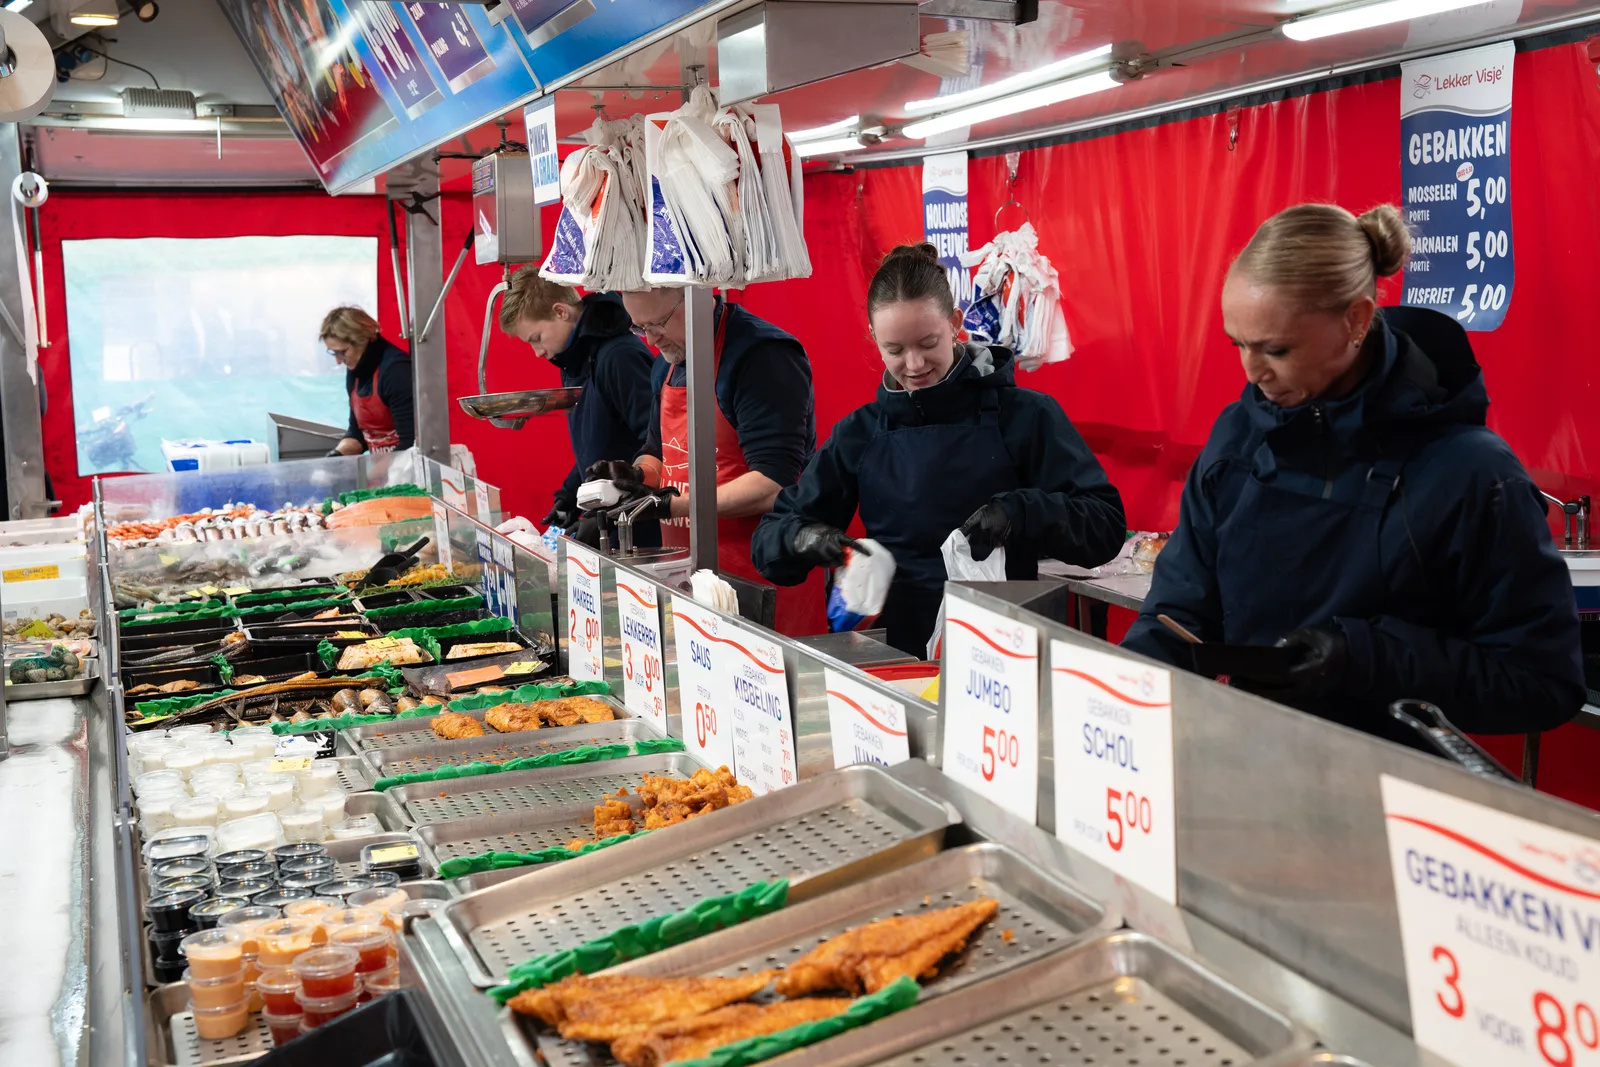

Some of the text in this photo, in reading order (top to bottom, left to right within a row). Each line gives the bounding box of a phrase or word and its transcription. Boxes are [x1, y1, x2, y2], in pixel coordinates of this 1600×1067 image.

[1408, 121, 1507, 165] GEBAKKEN
[926, 202, 968, 230] HOLLANDSE
[1408, 176, 1506, 220] MOSSELEN 5,00
[1409, 210, 1430, 222] PORTIE
[1409, 261, 1430, 272] PORTIE
[1466, 230, 1508, 273] 5,00
[1407, 284, 1506, 323] VISFRIET 5,00
[572, 586, 596, 615] MAKREEL
[570, 608, 577, 643] 2
[622, 614, 658, 652] LEKKERBEK
[624, 643, 633, 681] 3
[634, 671, 645, 689] VOOR
[690, 640, 711, 670] SAUS
[733, 675, 782, 721] KIBBELING
[966, 669, 1011, 714] JUMBO
[1083, 722, 1139, 773] SCHOL
[1405, 849, 1565, 942] GEBAKKEN
[1456, 914, 1578, 984] ALLEEN KOUD
[1432, 944, 1466, 1019] 3
